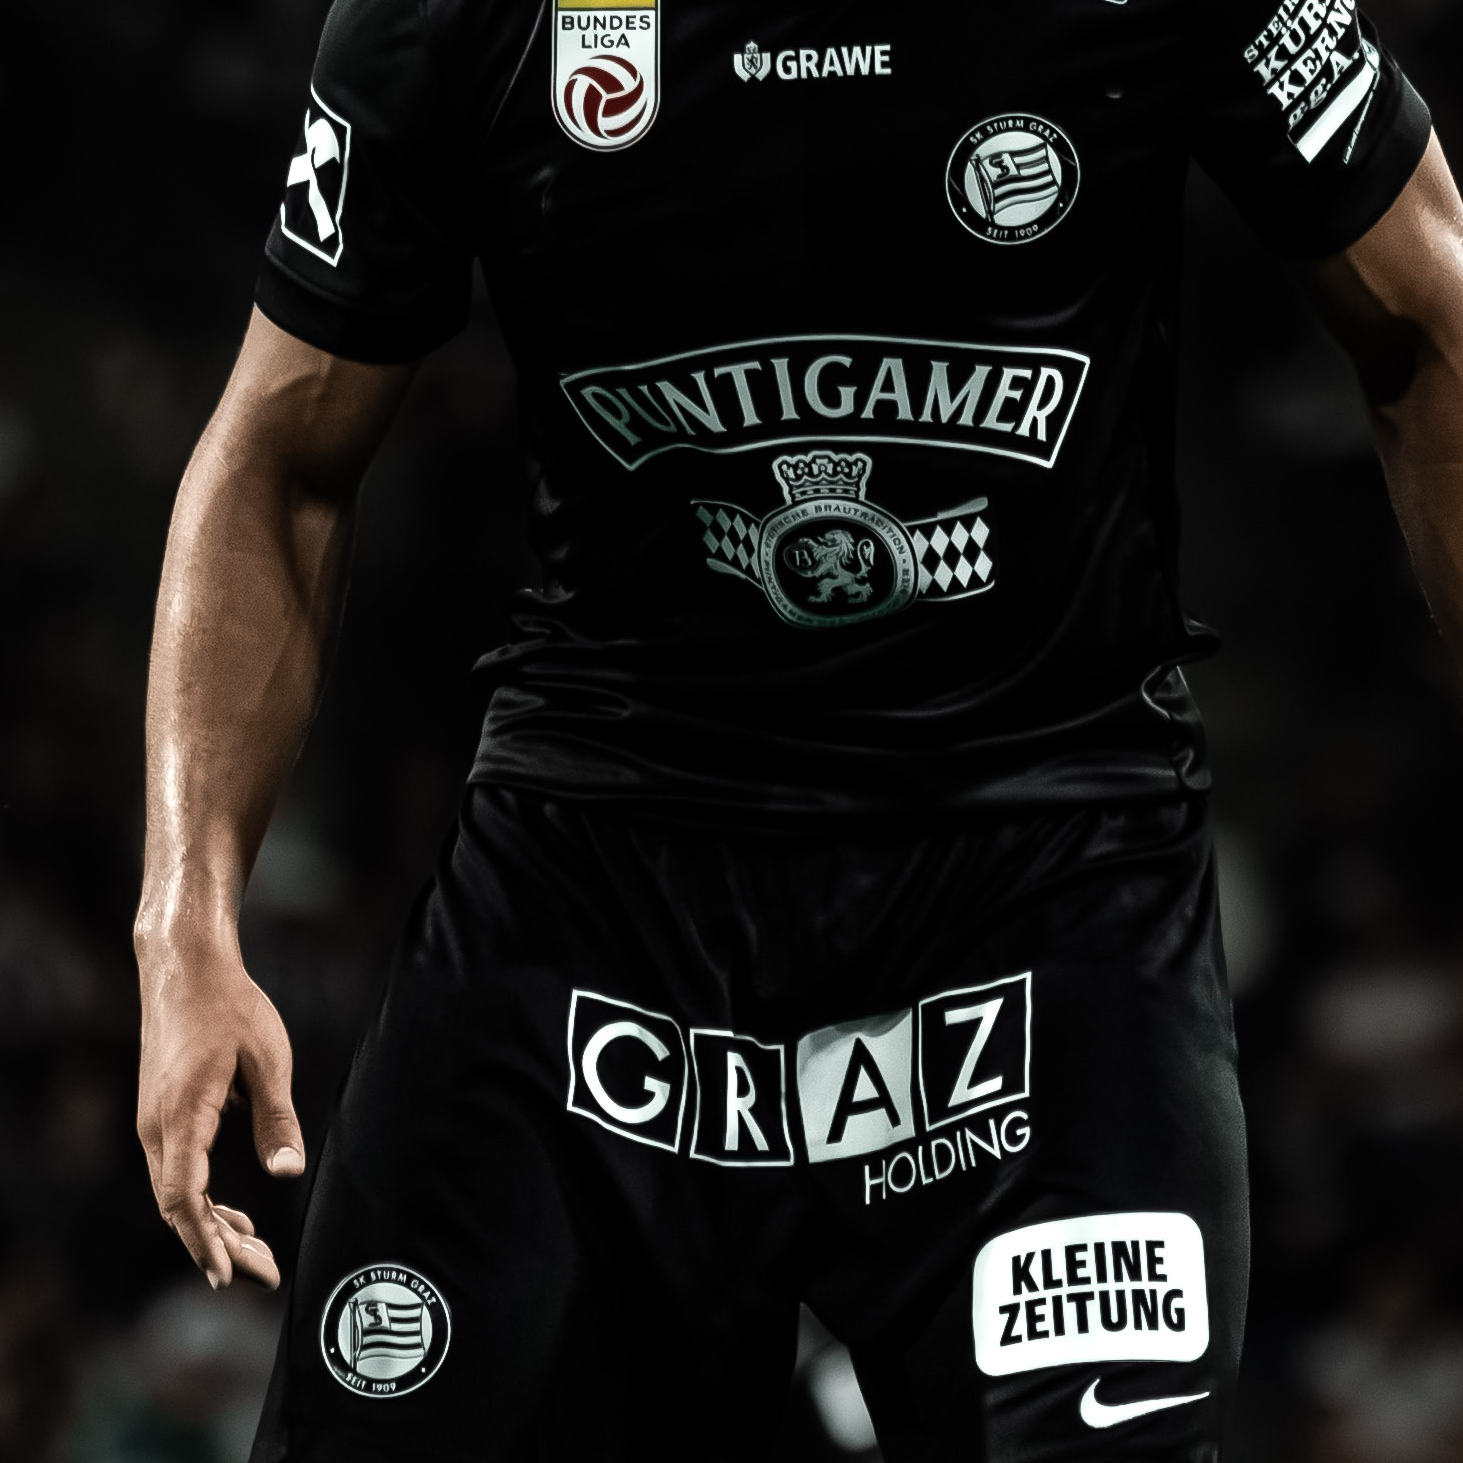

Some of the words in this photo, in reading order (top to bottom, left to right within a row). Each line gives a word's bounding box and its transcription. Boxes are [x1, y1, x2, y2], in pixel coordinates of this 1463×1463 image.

[561, 15, 651, 31] BUNDES
[581, 32, 631, 49] LIGA
[776, 44, 892, 80] GRAWE
[969, 131, 984, 145] SK
[987, 119, 1024, 134] STURM
[1029, 122, 1058, 143] GRAZ
[986, 226, 1009, 239] SEIT
[580, 355, 1064, 446] PUNTIGAMER
[581, 997, 1004, 1151] GRAZ
[864, 1111, 1031, 1204] HOLDING
[1011, 1240, 1167, 1296] KLEINE
[353, 1274, 366, 1289] SK
[370, 1269, 407, 1283] STURM
[410, 1279, 437, 1306] GRAZ
[998, 1287, 1185, 1347] ZEITUNG
